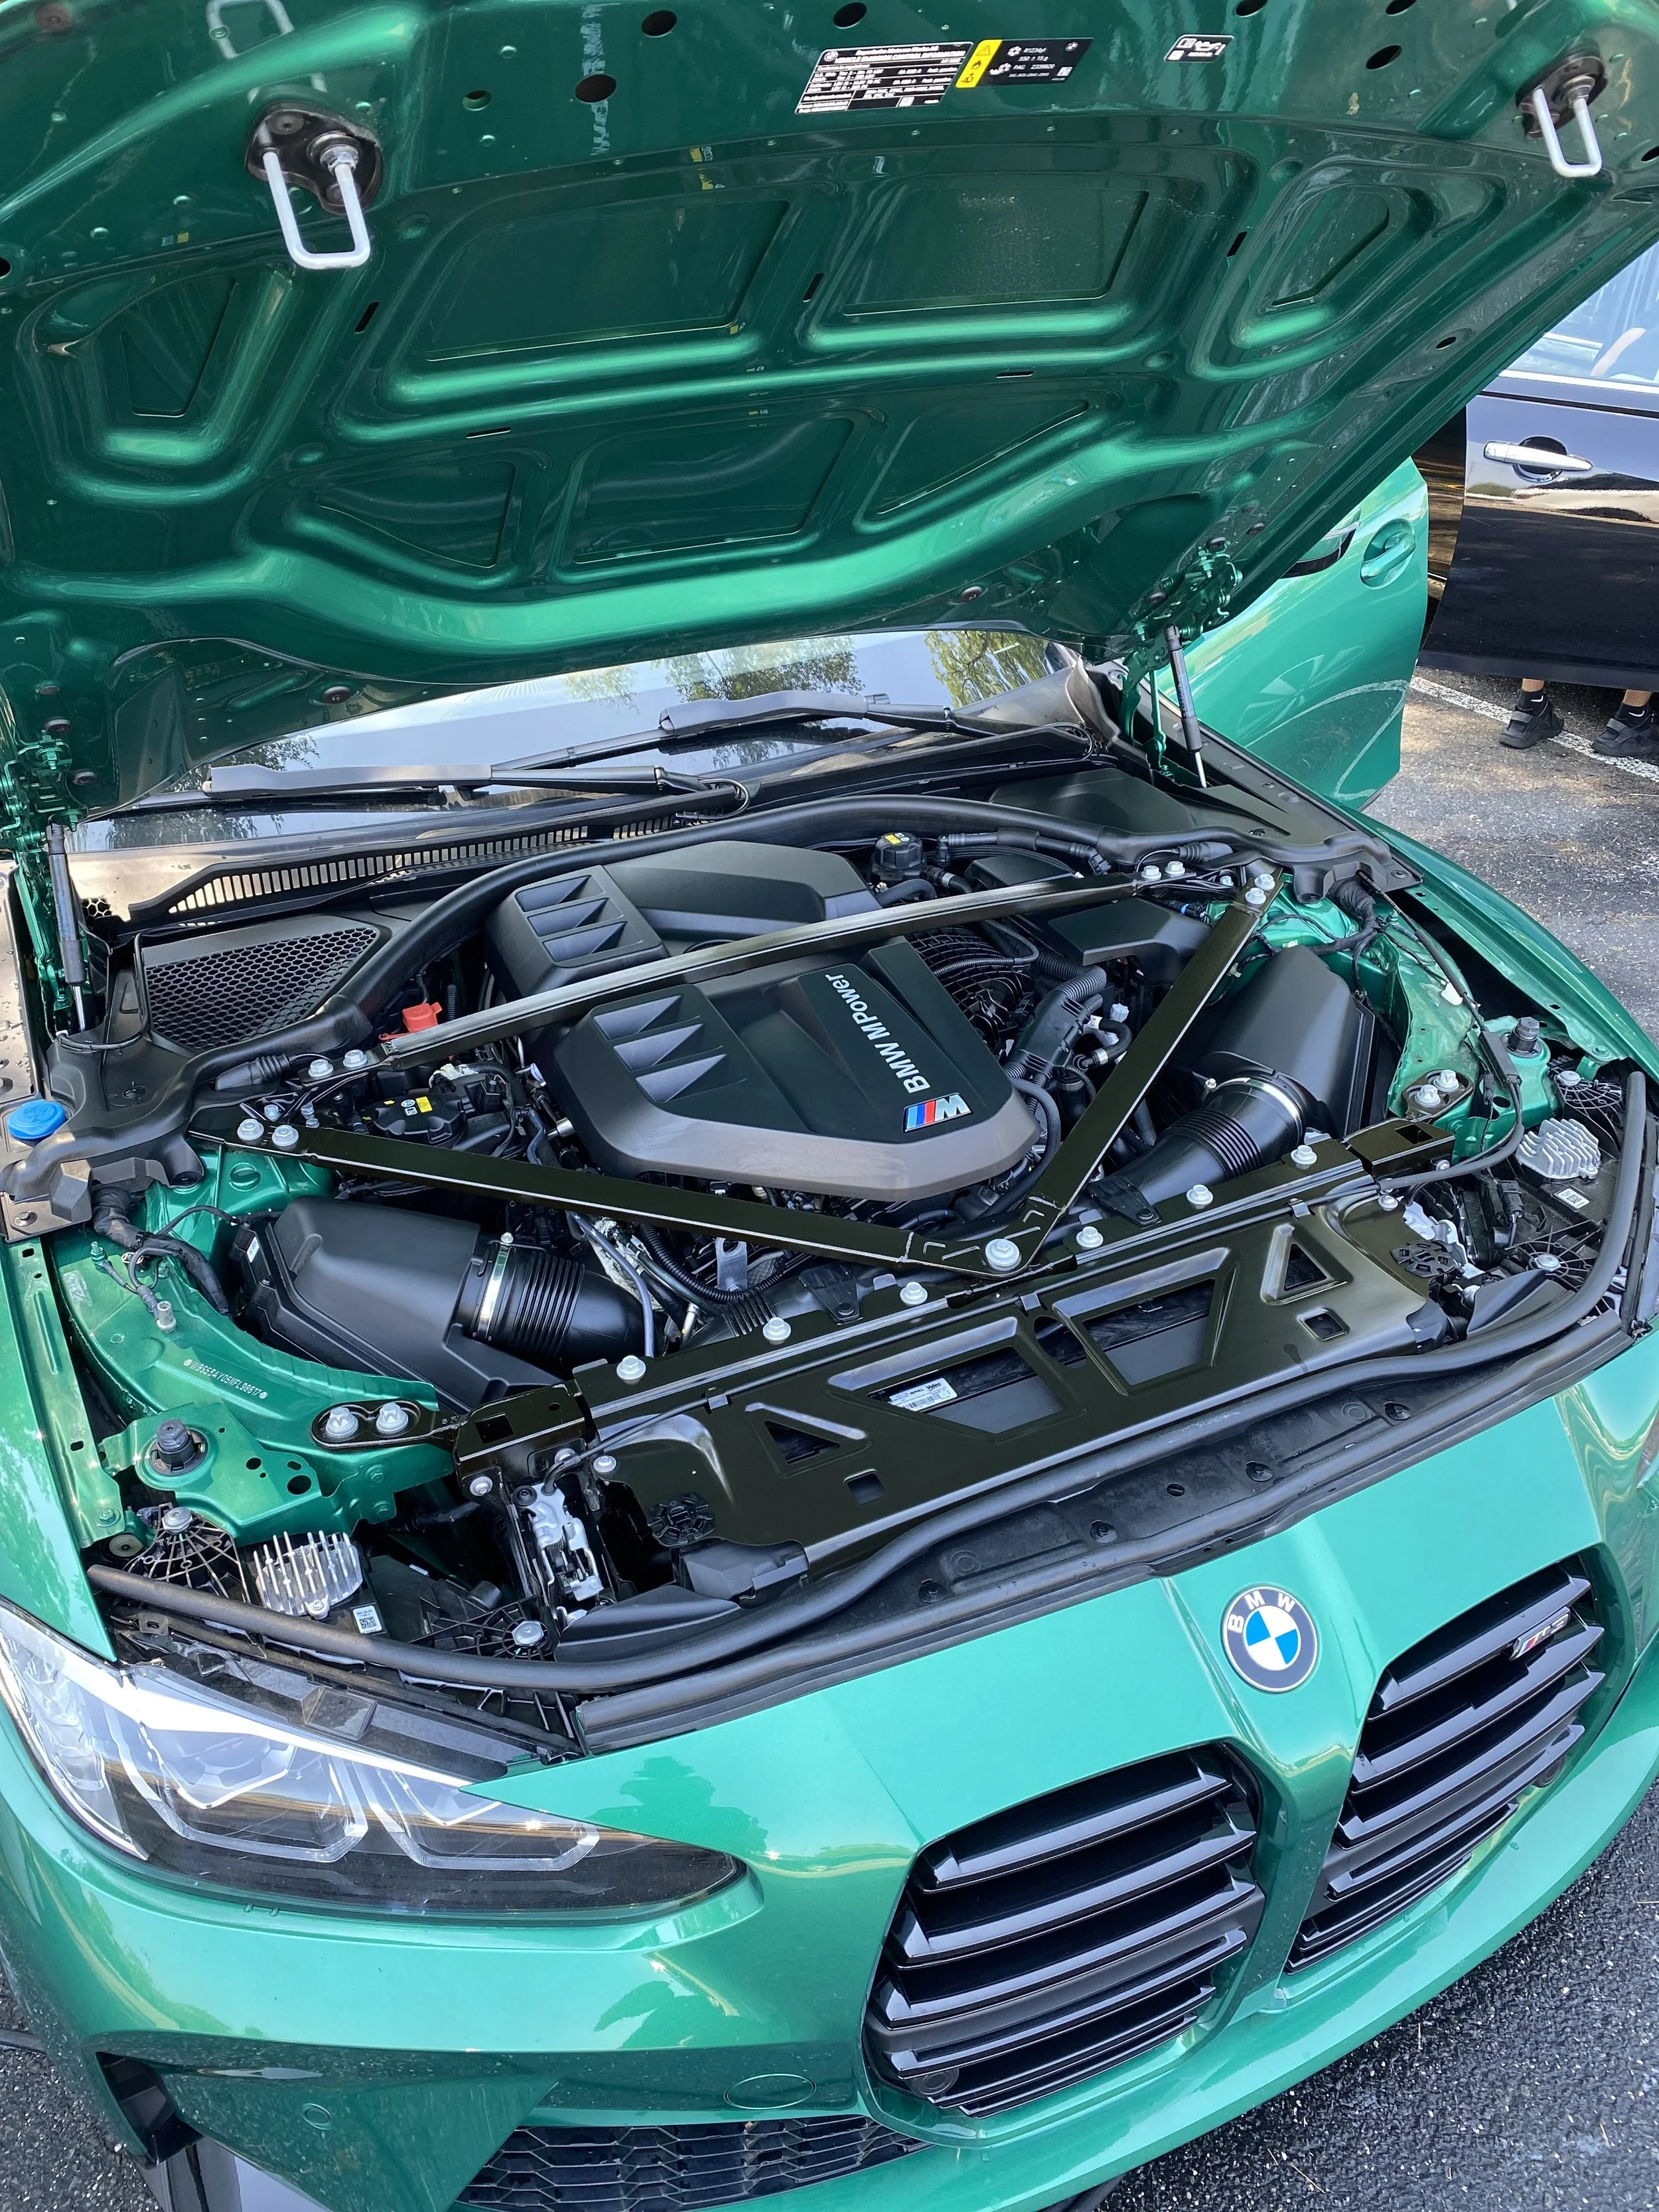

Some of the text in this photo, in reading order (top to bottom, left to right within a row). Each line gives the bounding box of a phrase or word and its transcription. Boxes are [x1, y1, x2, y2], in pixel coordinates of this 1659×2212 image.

[825, 974, 930, 1093] BMW MPower
[1228, 1590, 1296, 1633] BMW
